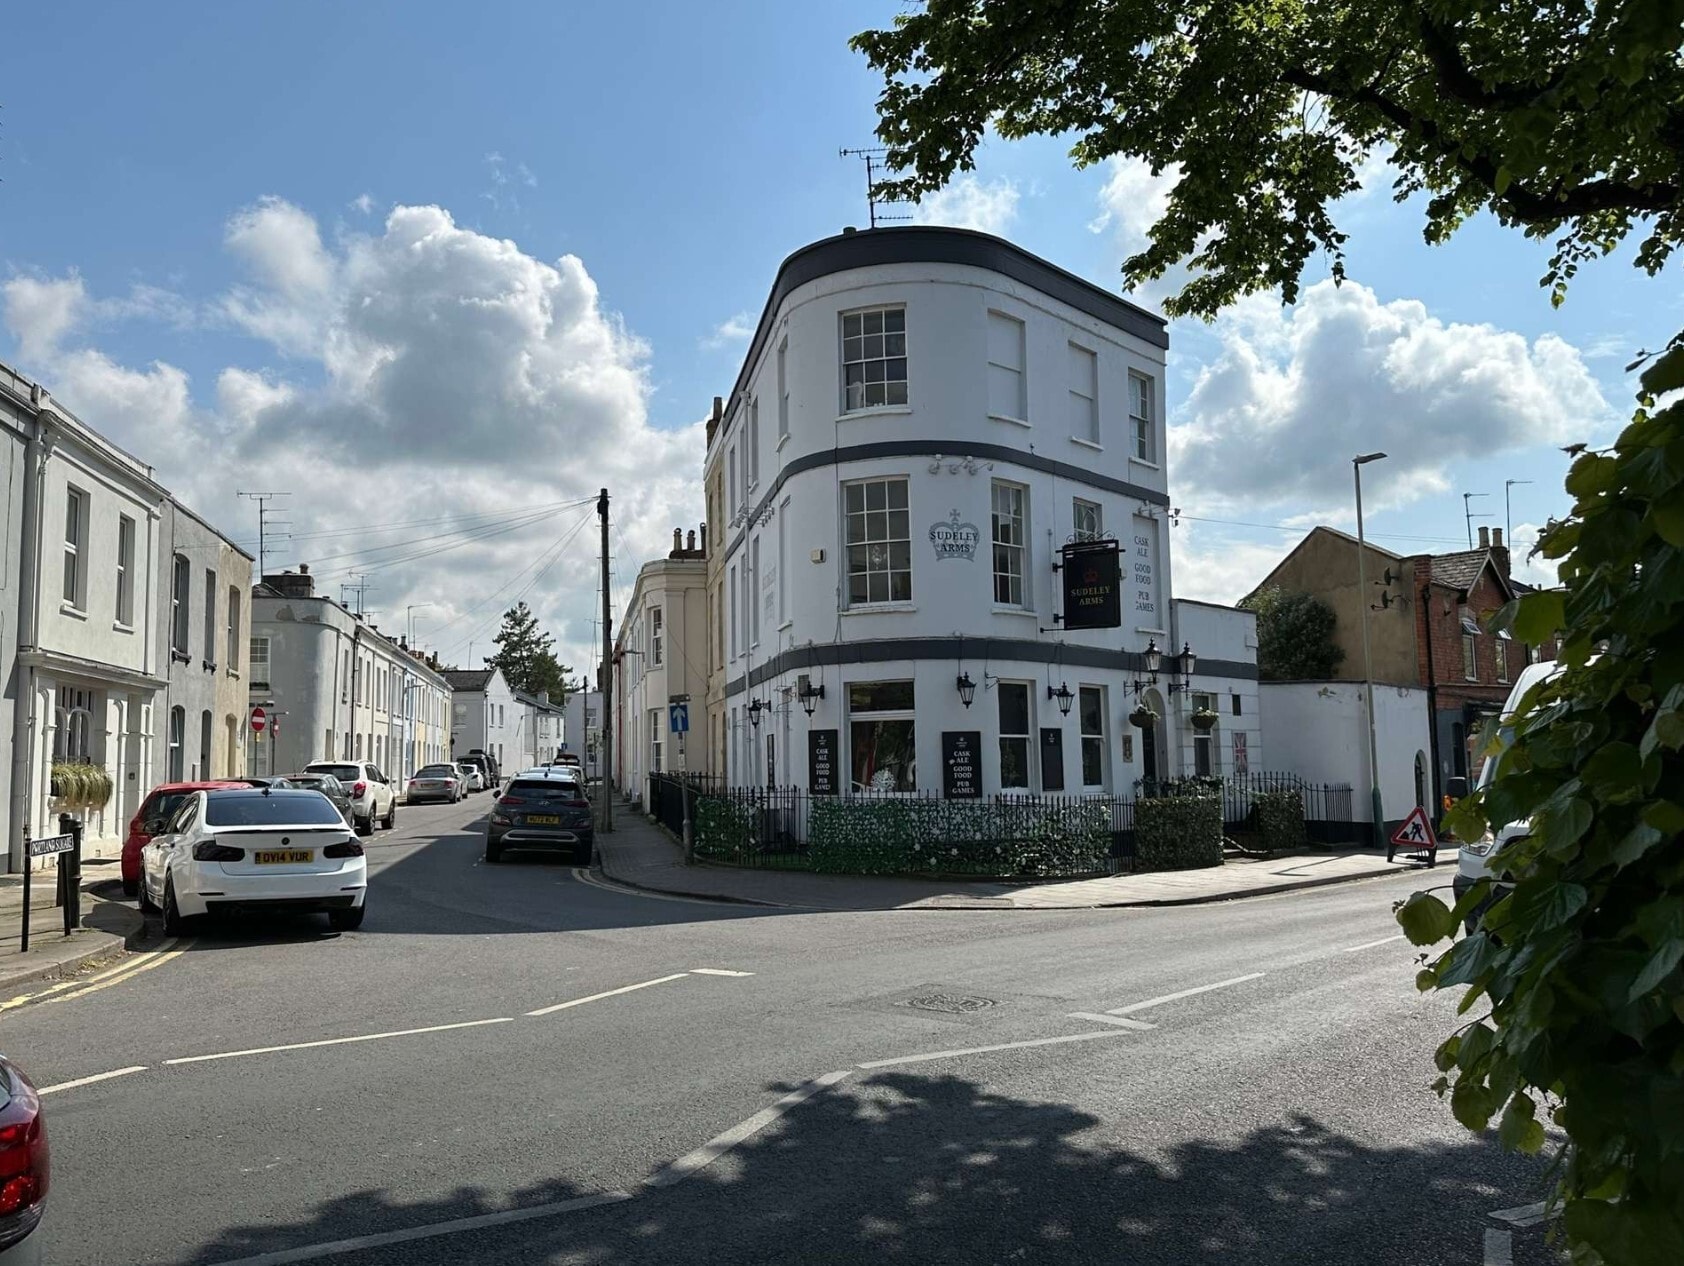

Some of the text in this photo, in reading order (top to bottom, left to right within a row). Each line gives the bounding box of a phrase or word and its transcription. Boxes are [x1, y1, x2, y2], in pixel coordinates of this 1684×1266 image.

[930, 531, 978, 541] SUDELEY
[1134, 535, 1149, 547] CASK
[940, 543, 970, 553] ARMS
[1136, 547, 1149, 557] ALE
[1134, 562, 1151, 574] GOOD
[1135, 574, 1151, 585] FOOD
[1071, 585, 1110, 597] SUDELEY
[1138, 590, 1149, 601] PUB
[1079, 596, 1104, 605] ARMS
